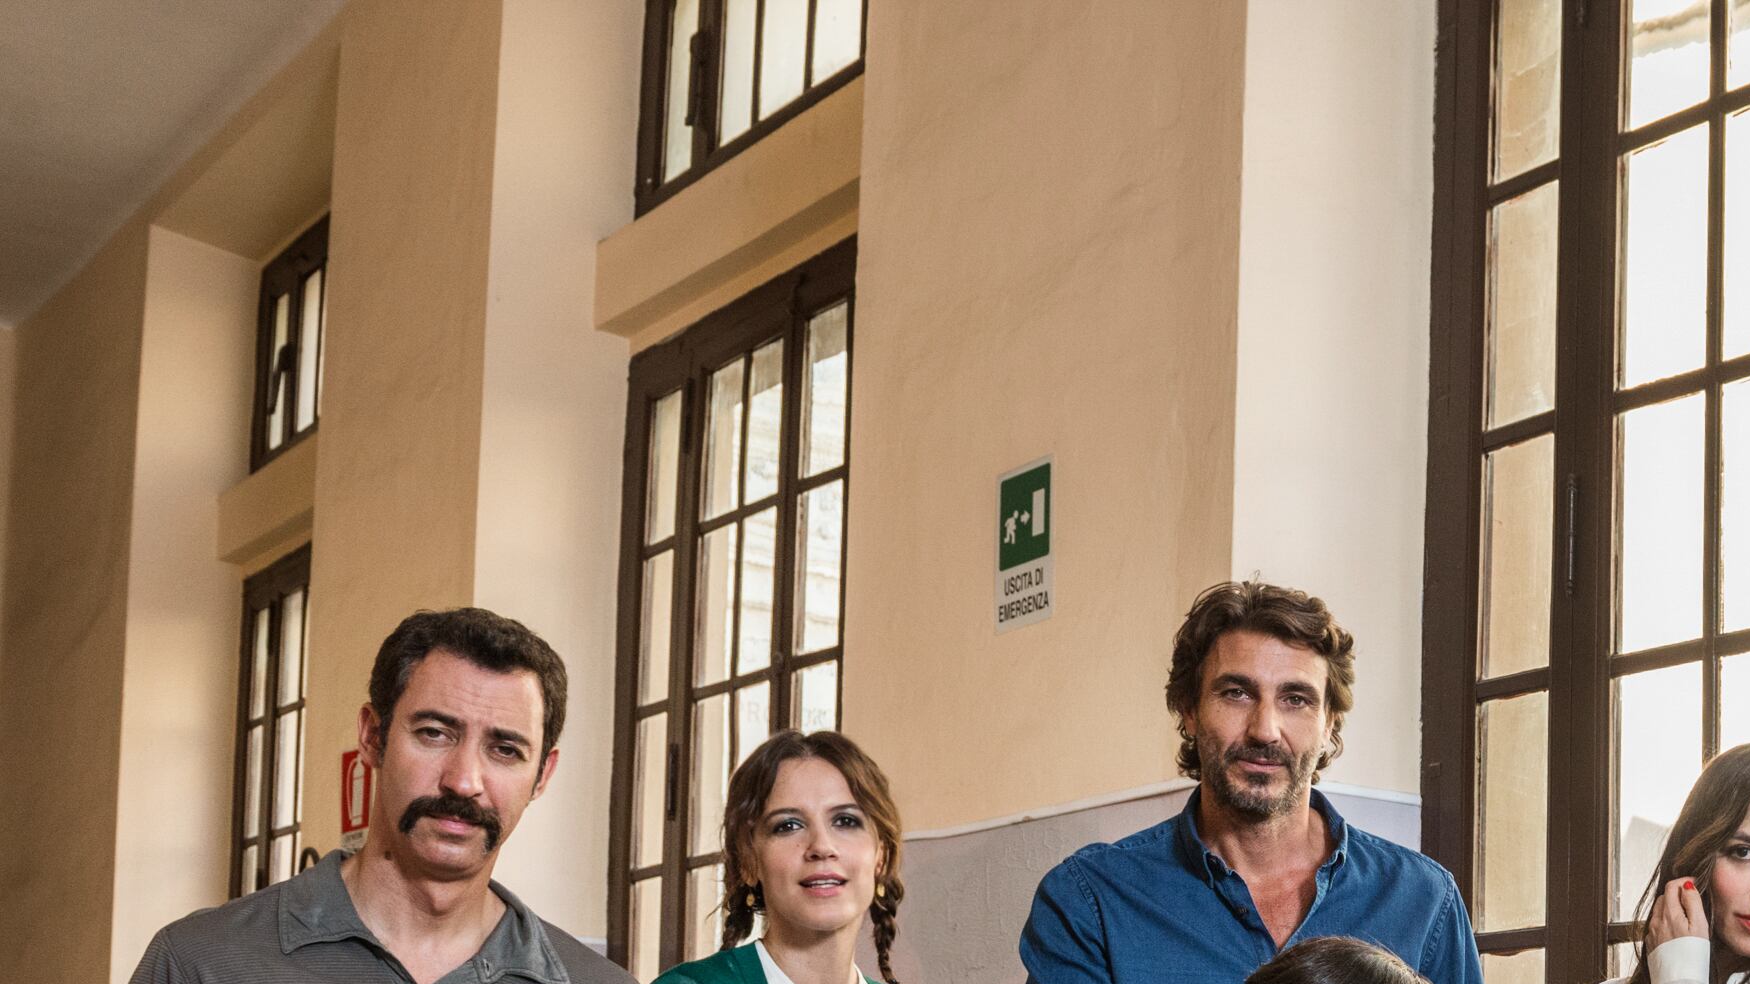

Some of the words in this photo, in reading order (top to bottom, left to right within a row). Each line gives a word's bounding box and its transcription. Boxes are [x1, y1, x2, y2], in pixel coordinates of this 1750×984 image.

[1004, 572, 1033, 596] USCITA
[1035, 567, 1044, 586] DI
[999, 591, 1050, 623] EMERGENZA
